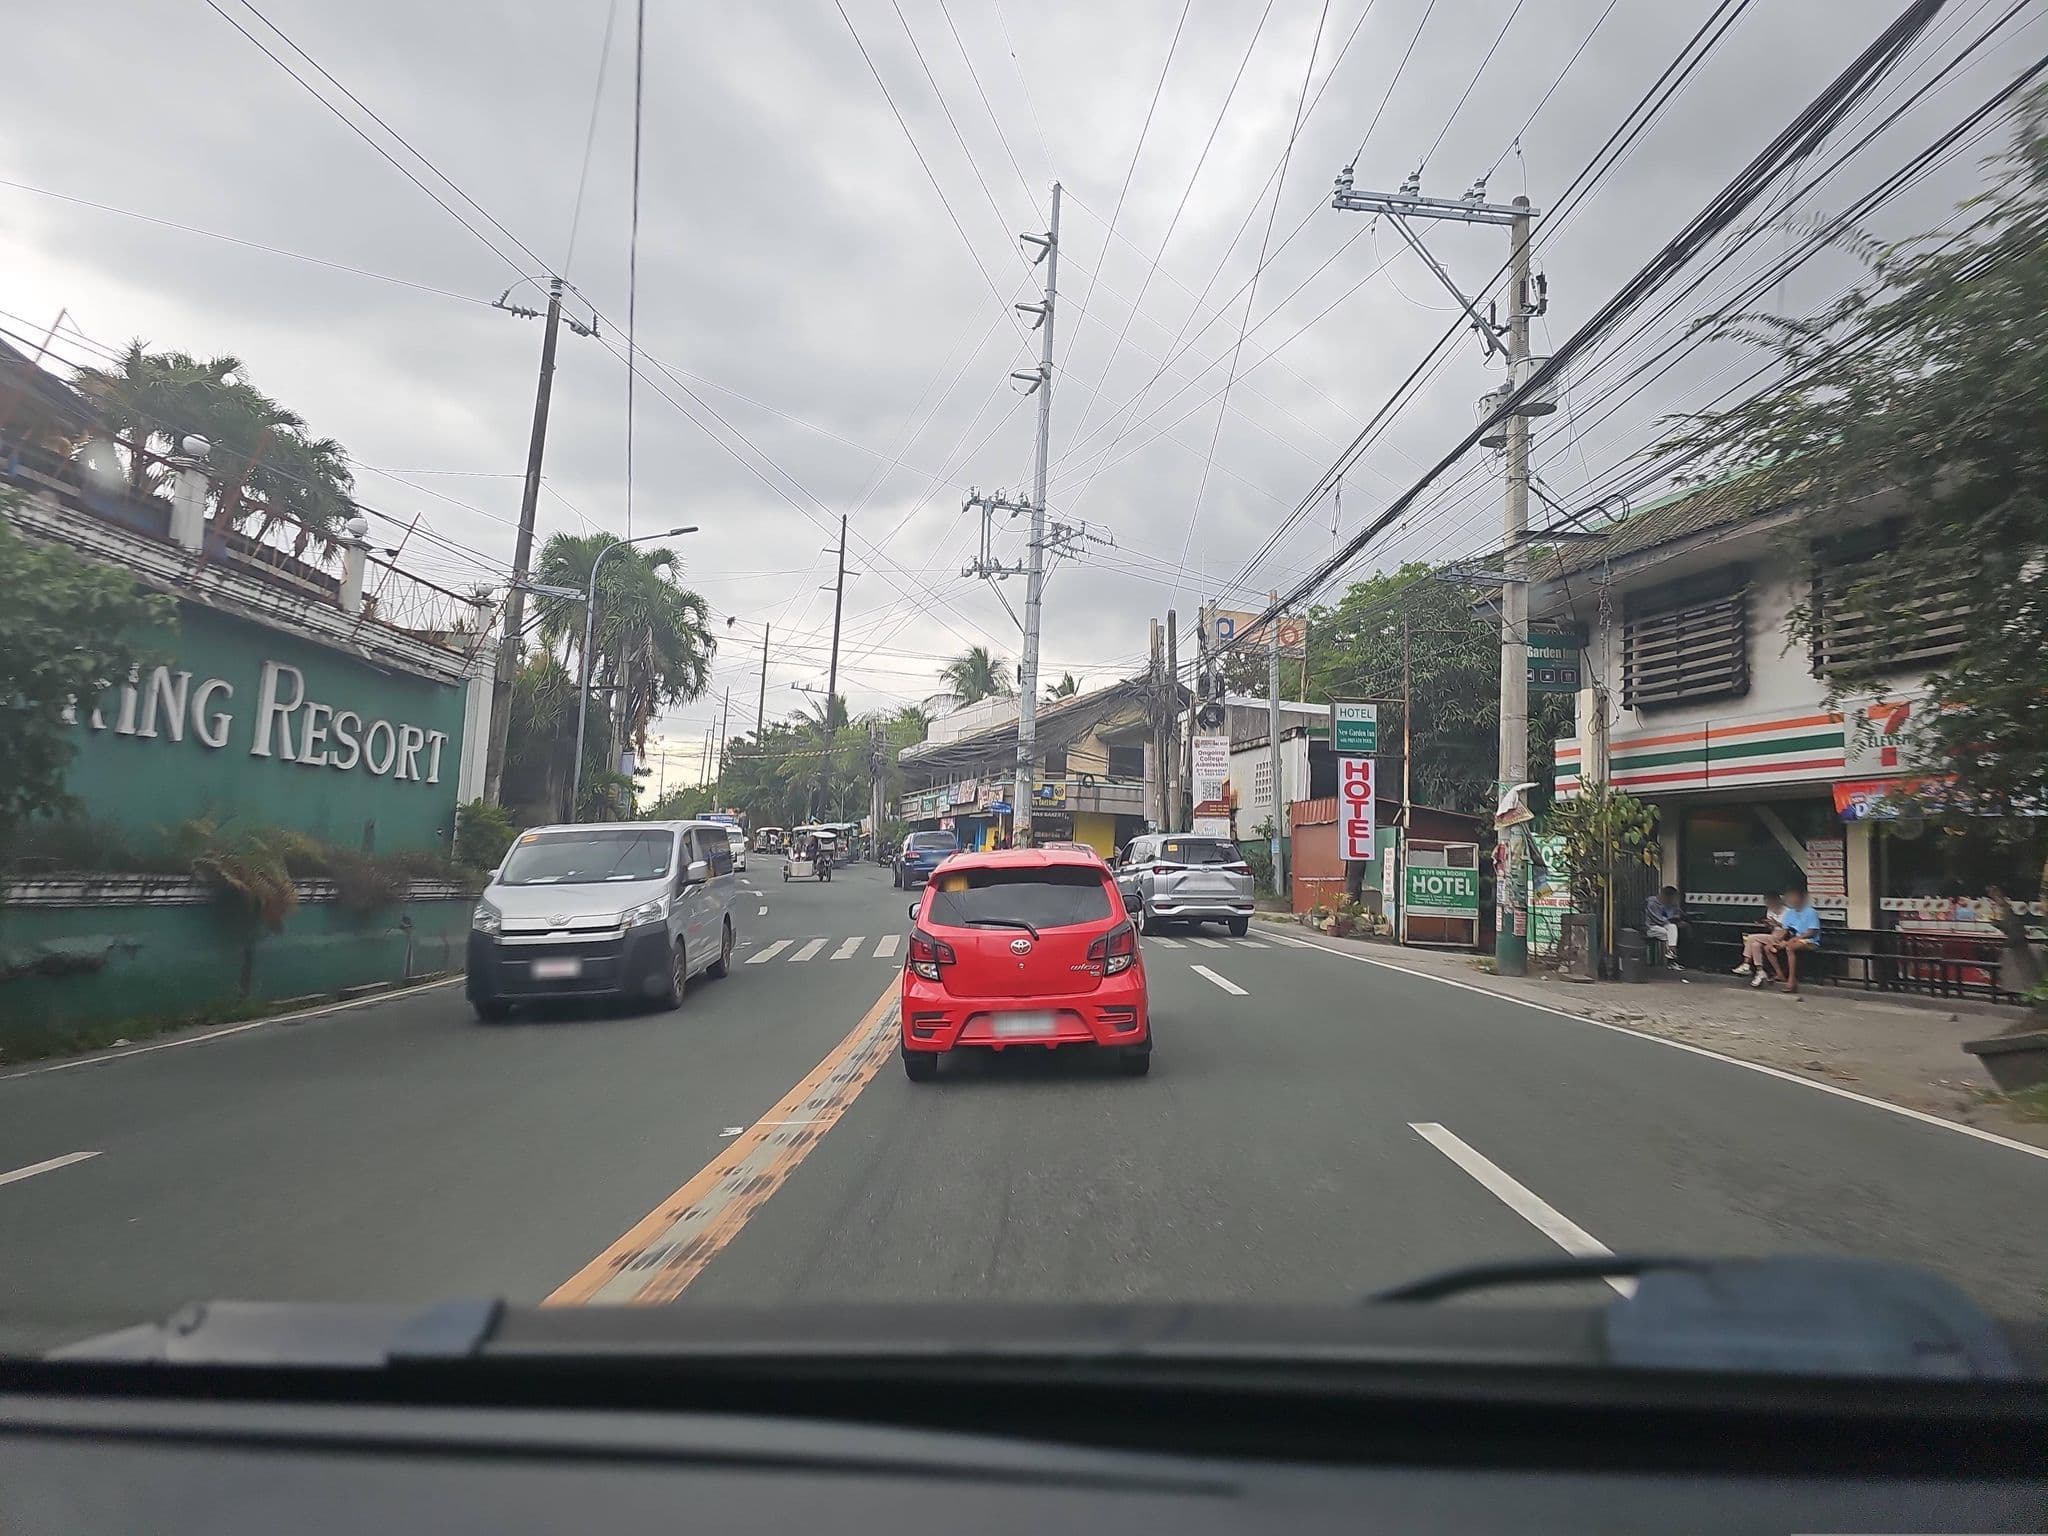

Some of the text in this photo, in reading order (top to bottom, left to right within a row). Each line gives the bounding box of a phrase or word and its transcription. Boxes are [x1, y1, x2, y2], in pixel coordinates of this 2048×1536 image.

[1527, 646, 1562, 659] Garden
[250, 660, 449, 784] RESORT
[1340, 708, 1373, 719] HOTEL
[1349, 728, 1366, 737] Garden
[1344, 761, 1371, 858] HOTEL
[1412, 875, 1474, 896] HOTEL
